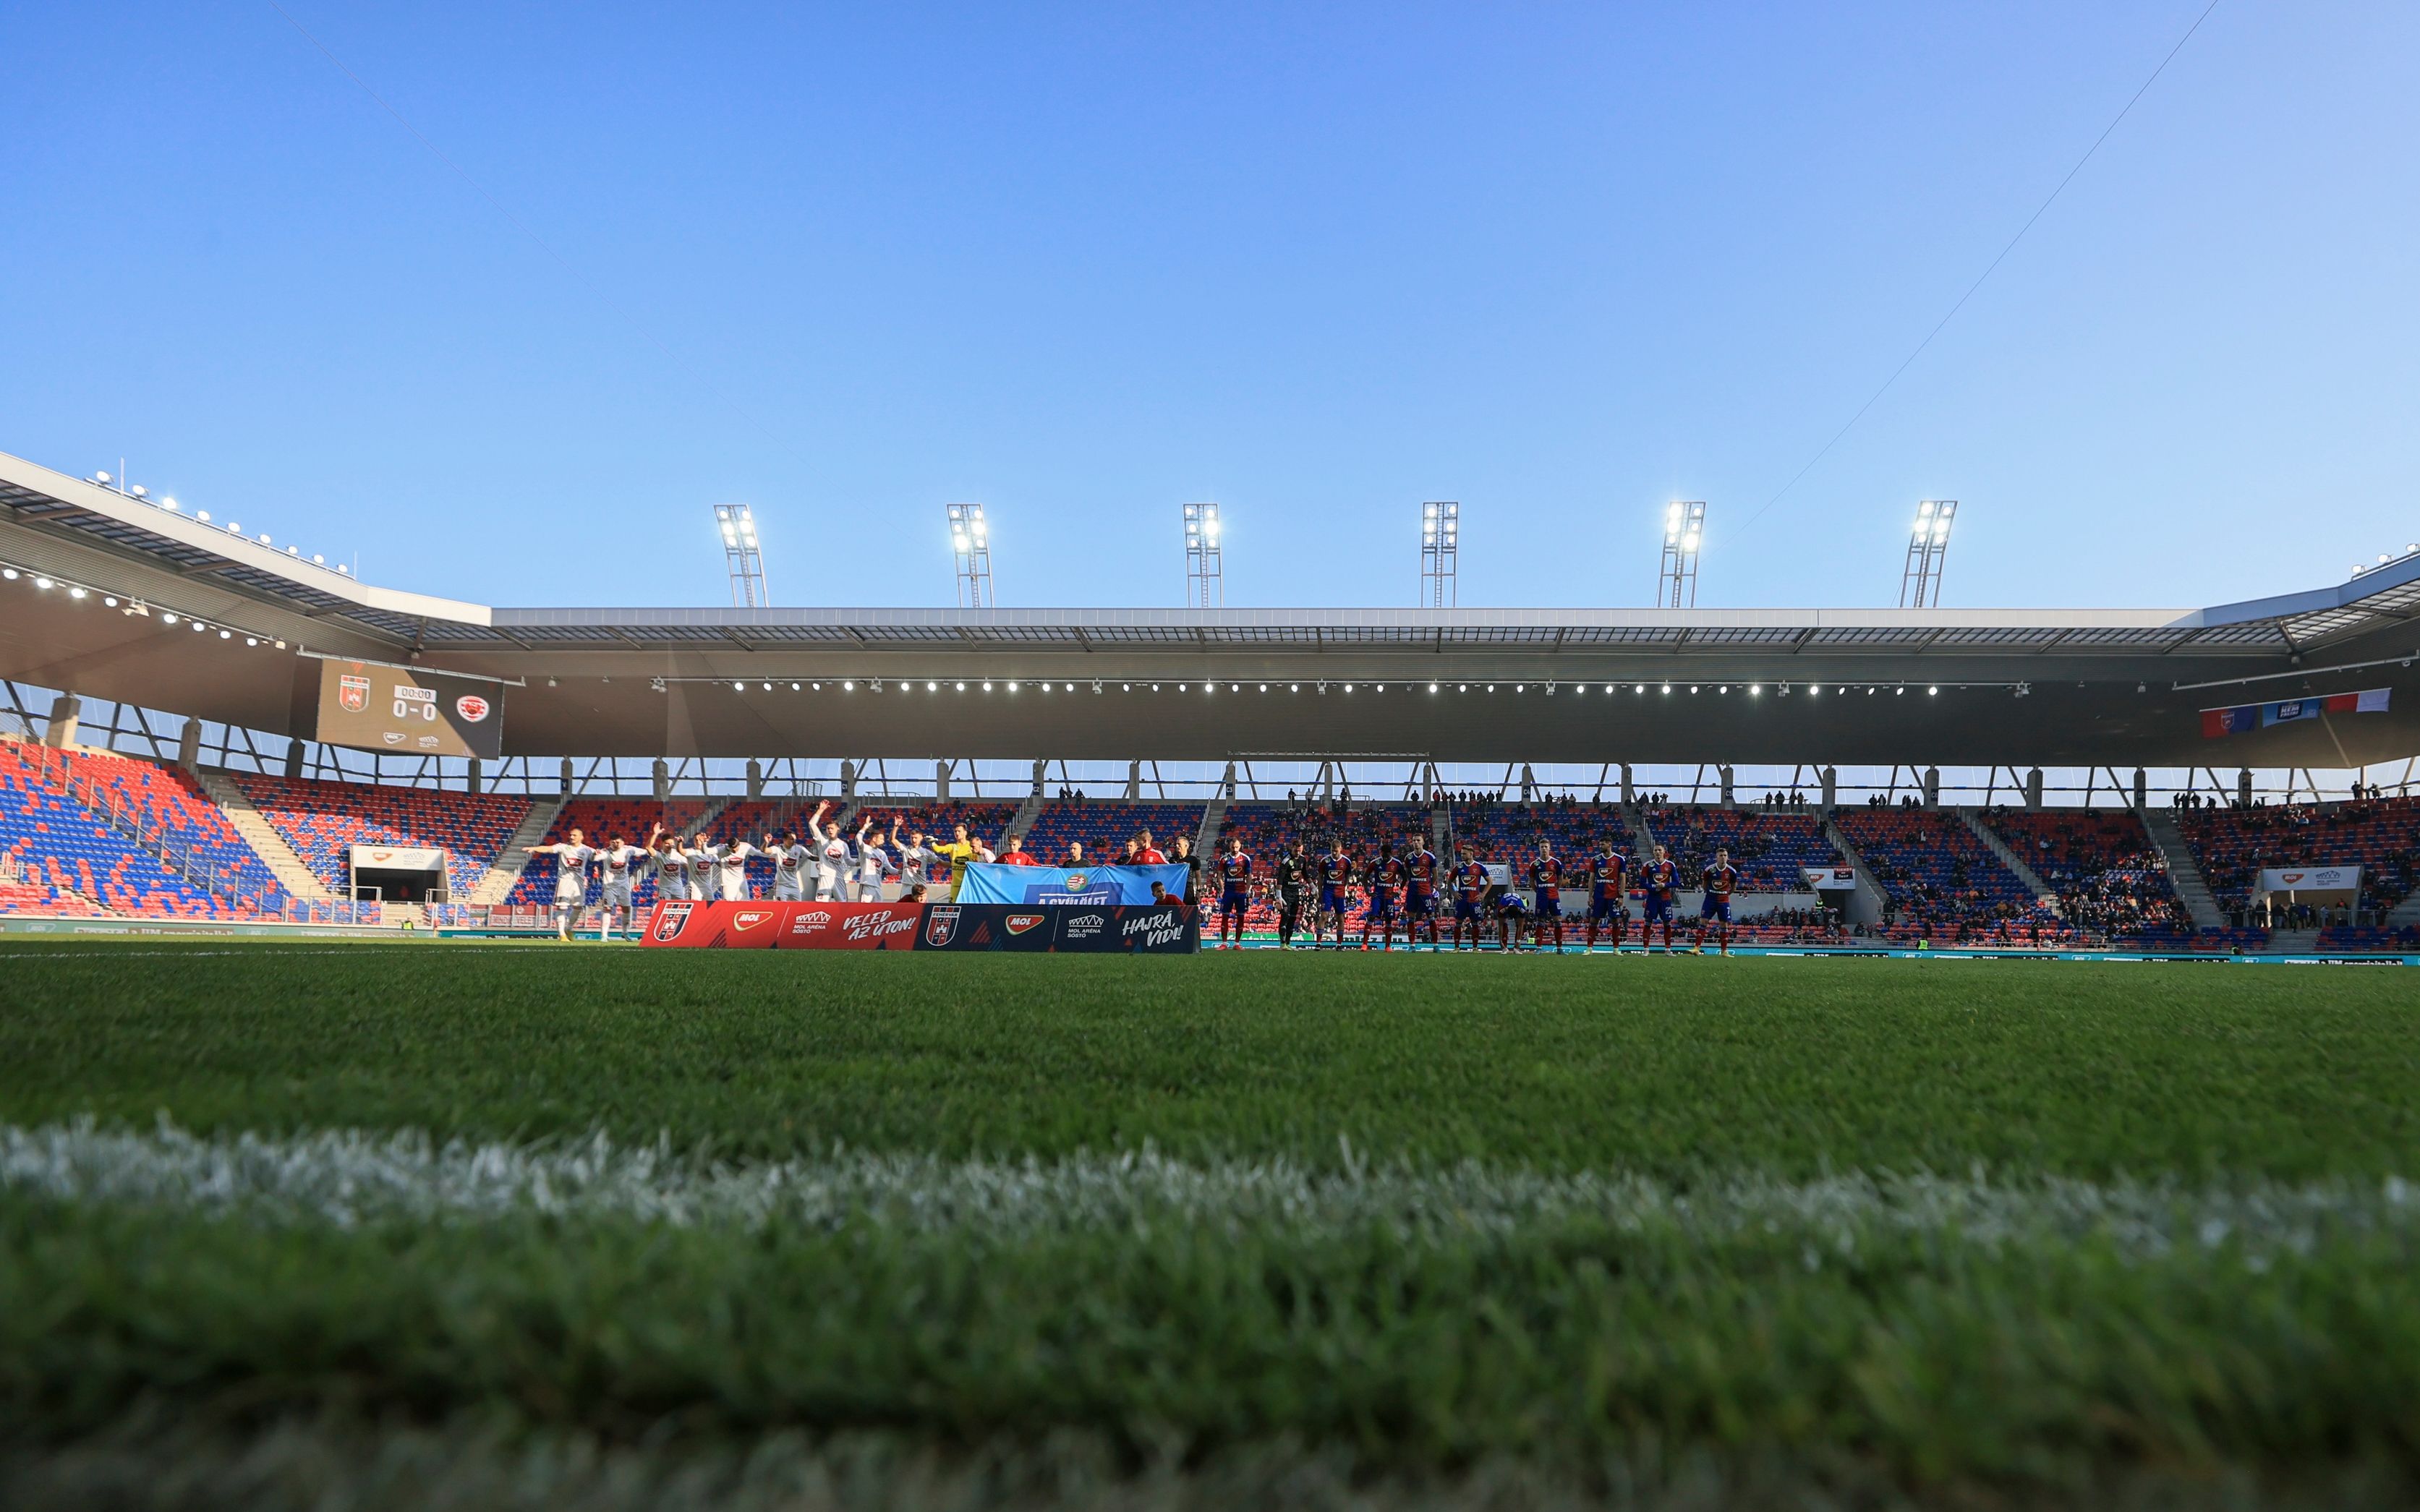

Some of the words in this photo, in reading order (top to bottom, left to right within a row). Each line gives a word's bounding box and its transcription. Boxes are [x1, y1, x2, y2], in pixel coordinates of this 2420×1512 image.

[401, 688, 431, 699] 00:00
[843, 910, 892, 930] VELED
[848, 926, 871, 940] AZ
[873, 916, 916, 936] ÚTON!
[1122, 910, 1175, 936] HAJRÁ,
[1147, 924, 1184, 947] VIDI!
